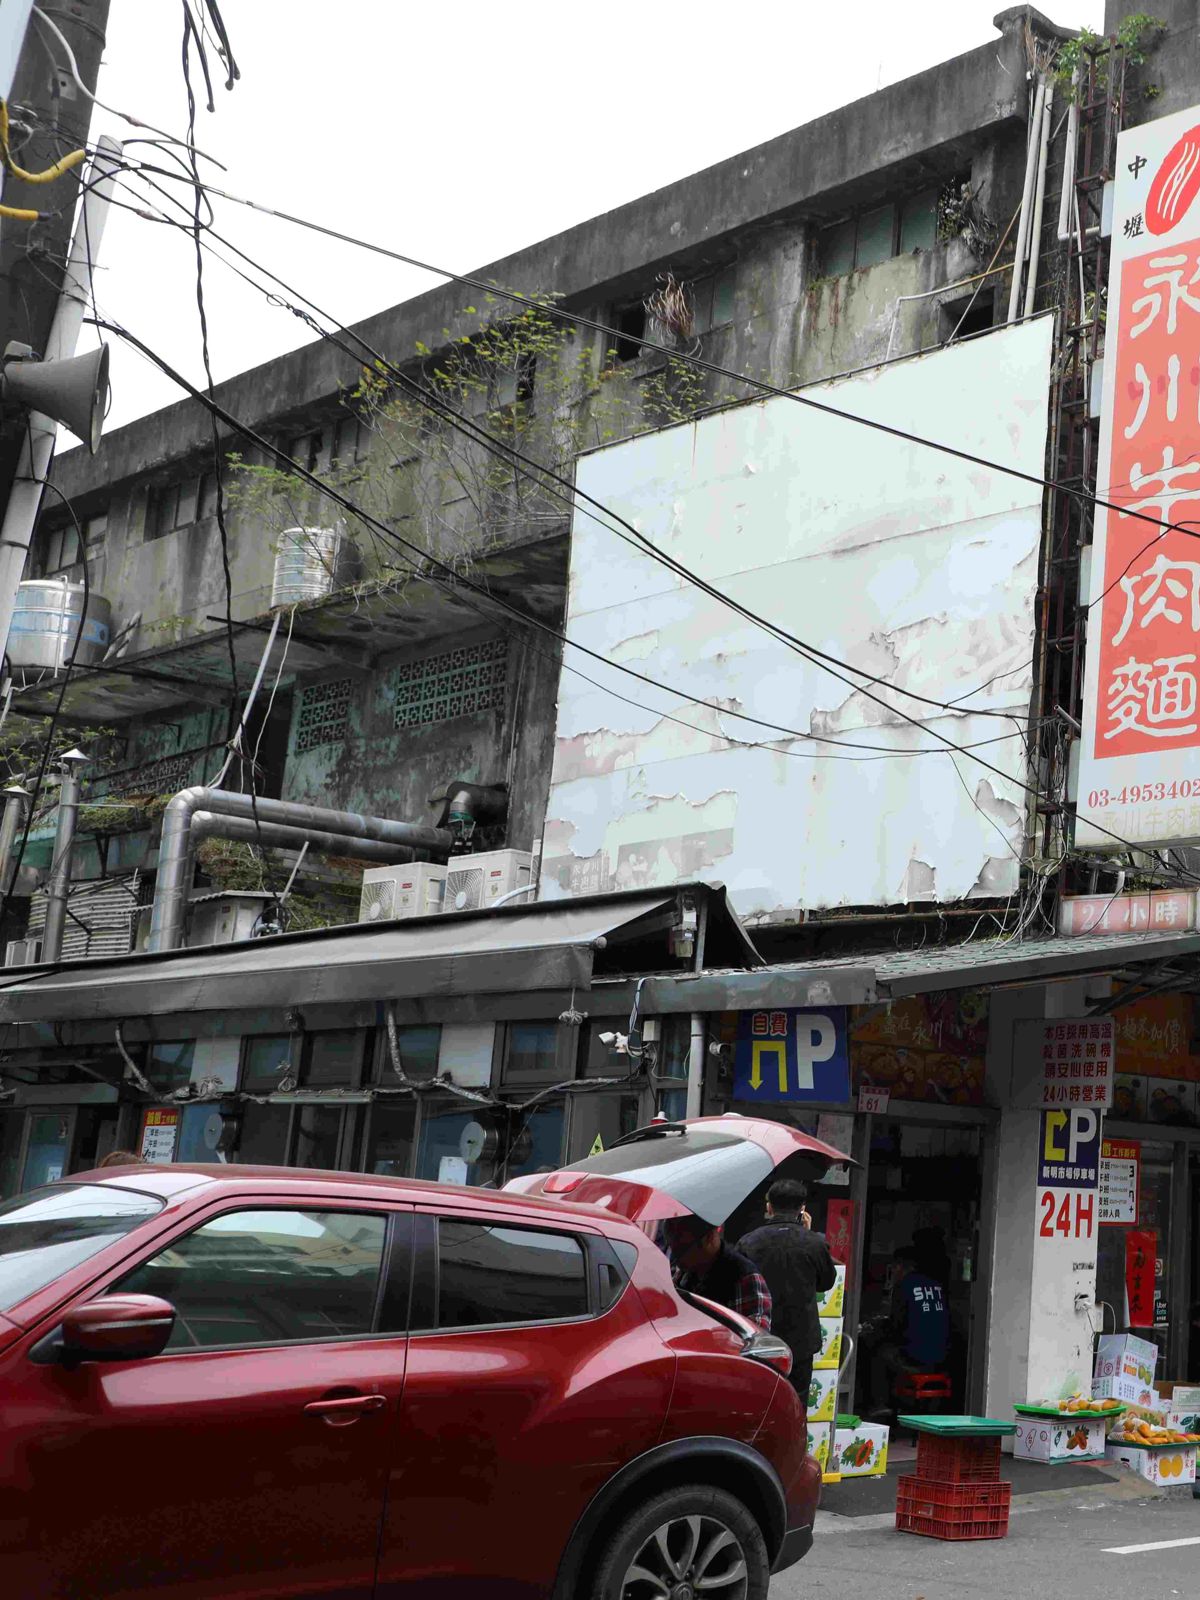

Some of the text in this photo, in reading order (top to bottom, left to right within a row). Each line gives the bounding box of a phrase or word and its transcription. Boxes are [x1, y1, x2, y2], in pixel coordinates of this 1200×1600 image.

[1122, 154, 1148, 241] 中壢
[1081, 899, 1179, 930] 24小時
[752, 1011, 787, 1037] 自費
[1043, 1022, 1112, 1042] 本店採用高溫
[796, 1014, 836, 1090] P
[1043, 1085, 1107, 1102] 24小時營業
[1068, 1108, 1097, 1163] P
[1042, 1165, 1096, 1181] 新明市場停車場
[1039, 1190, 1094, 1238] 24H
[913, 1286, 943, 1301] SHT
[921, 1301, 944, 1312] 台山
